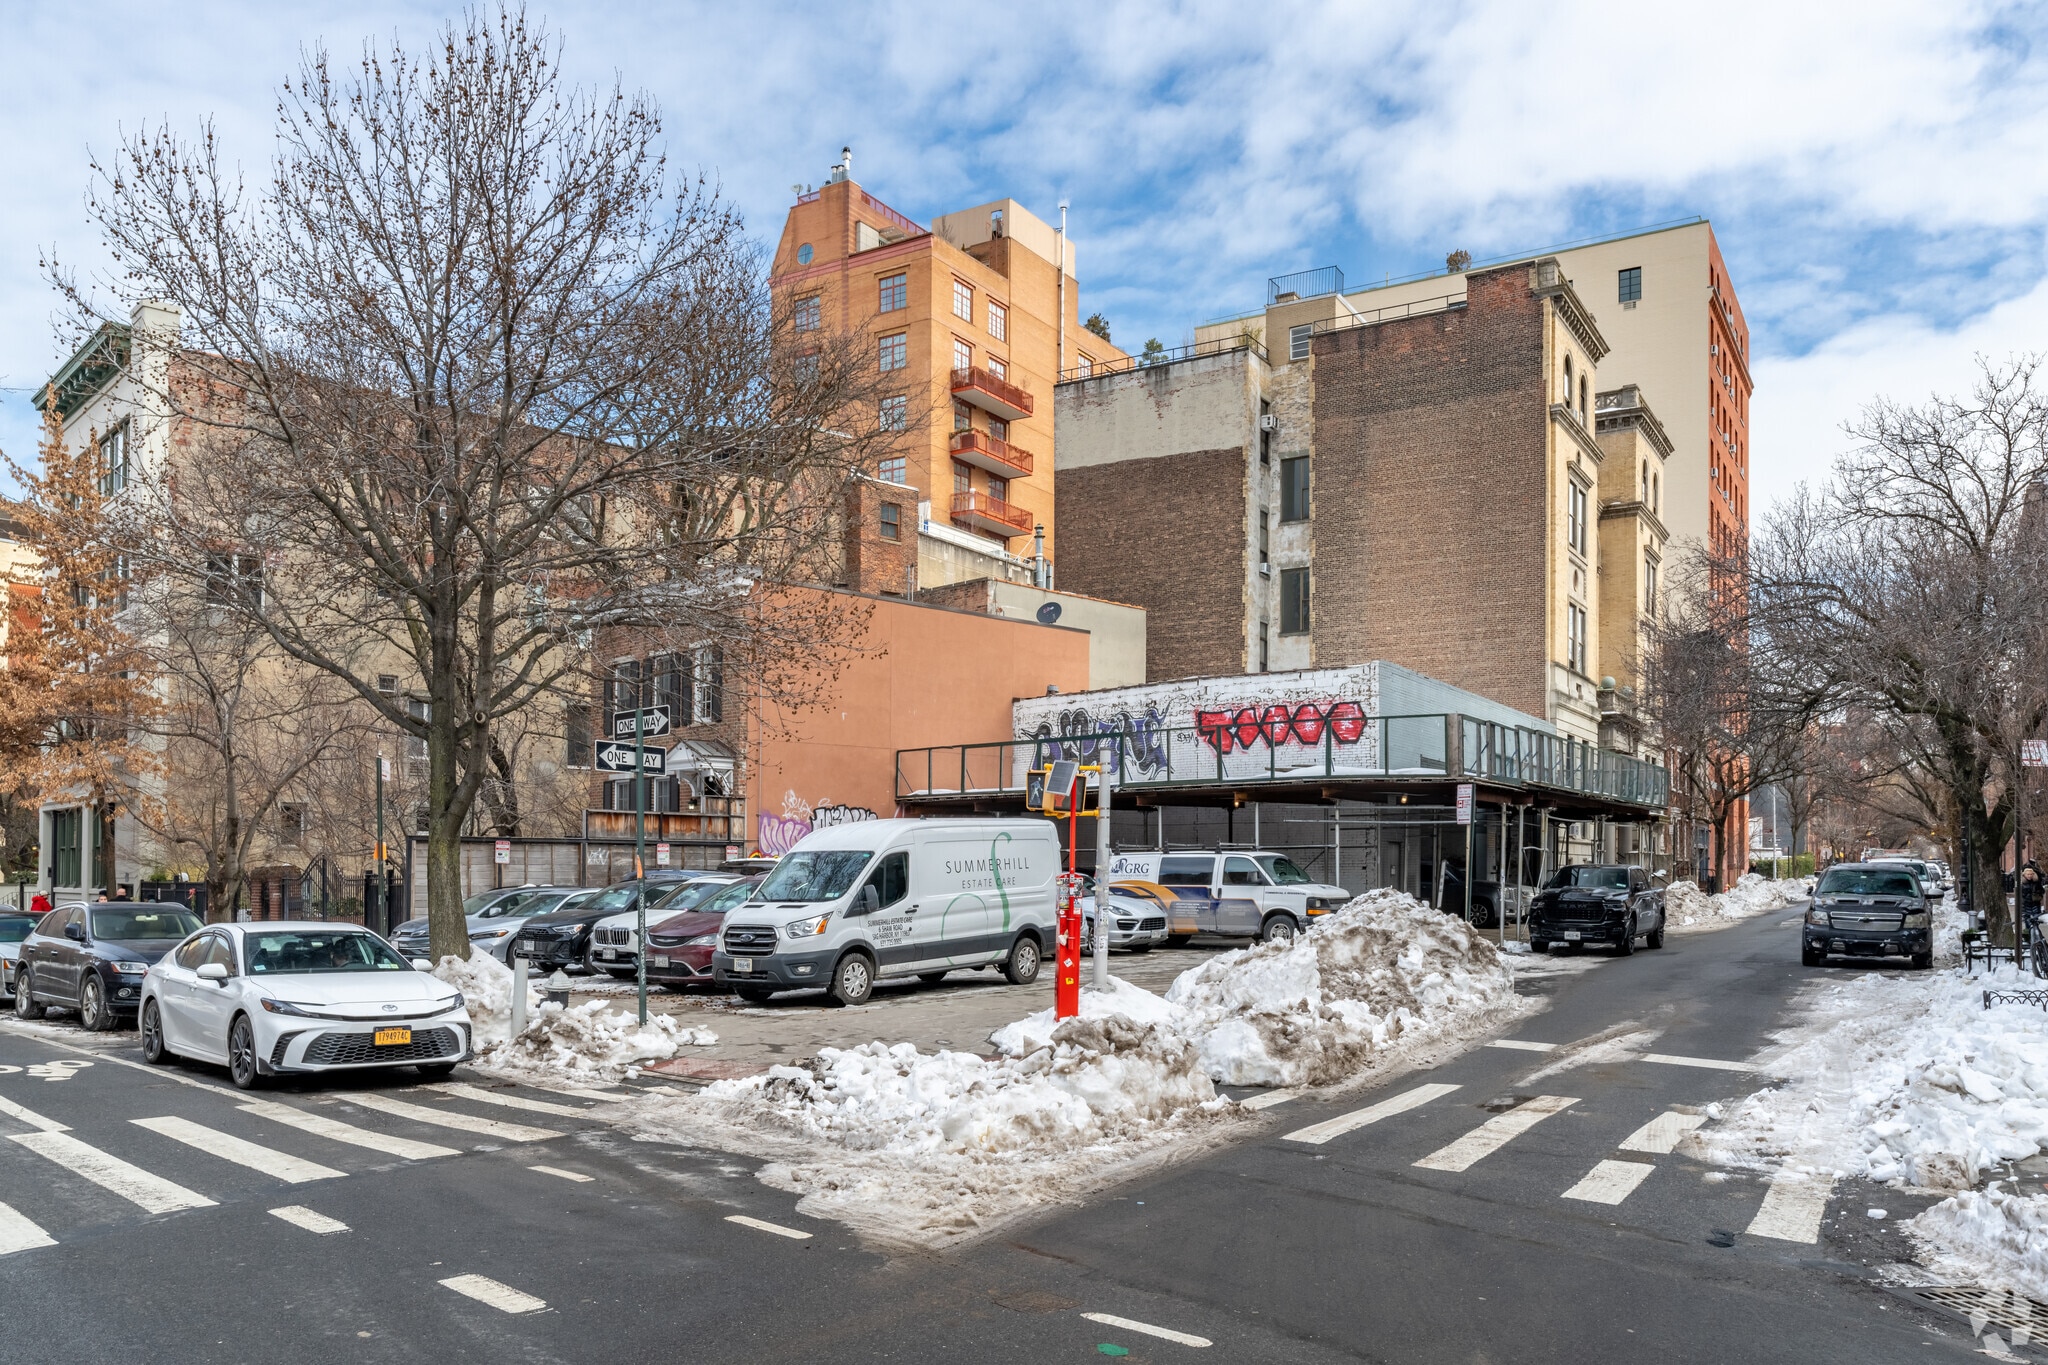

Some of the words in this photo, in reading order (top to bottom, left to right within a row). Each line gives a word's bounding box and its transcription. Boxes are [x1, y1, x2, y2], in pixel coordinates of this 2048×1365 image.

[618, 719, 635, 732] ONE
[643, 715, 662, 729] WAY
[607, 751, 627, 763] ONE
[644, 754, 657, 766] AY
[945, 857, 1030, 874] SUMMERHILL
[1124, 863, 1150, 874] GRG
[962, 878, 993, 889] ESTATE
[996, 876, 1016, 887] CARE
